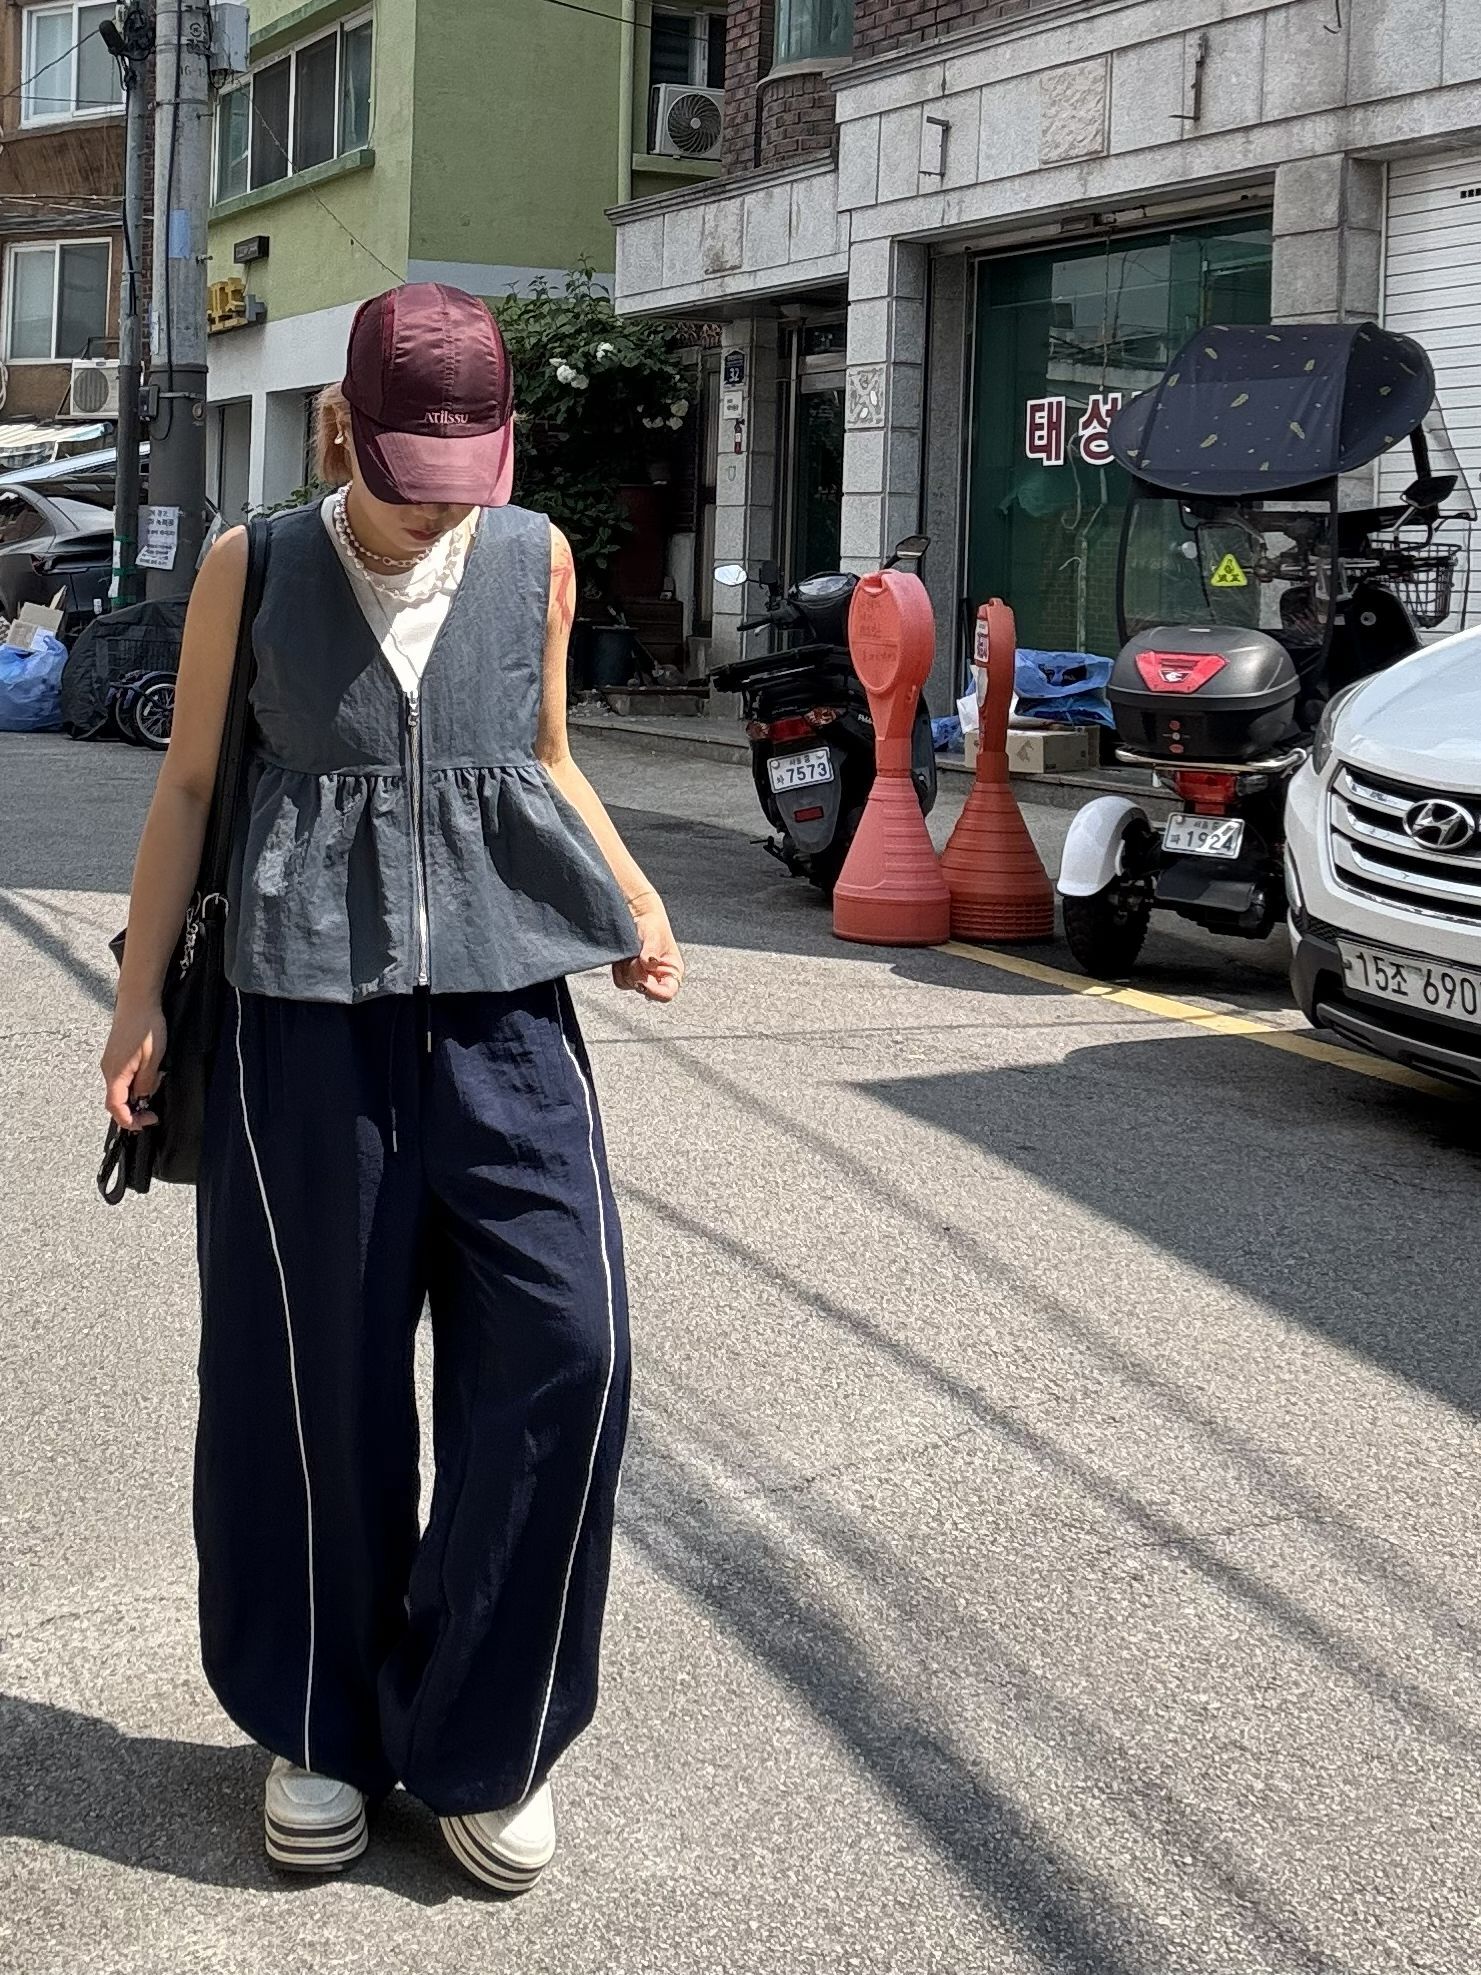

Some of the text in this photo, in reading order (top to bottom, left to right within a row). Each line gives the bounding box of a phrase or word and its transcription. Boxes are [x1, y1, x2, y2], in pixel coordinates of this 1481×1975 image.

[1026, 391, 1143, 466] 태성
[786, 762, 828, 784] 7573
[1187, 831, 1235, 851] 1924
[1356, 952, 1481, 1015] 15조 690
